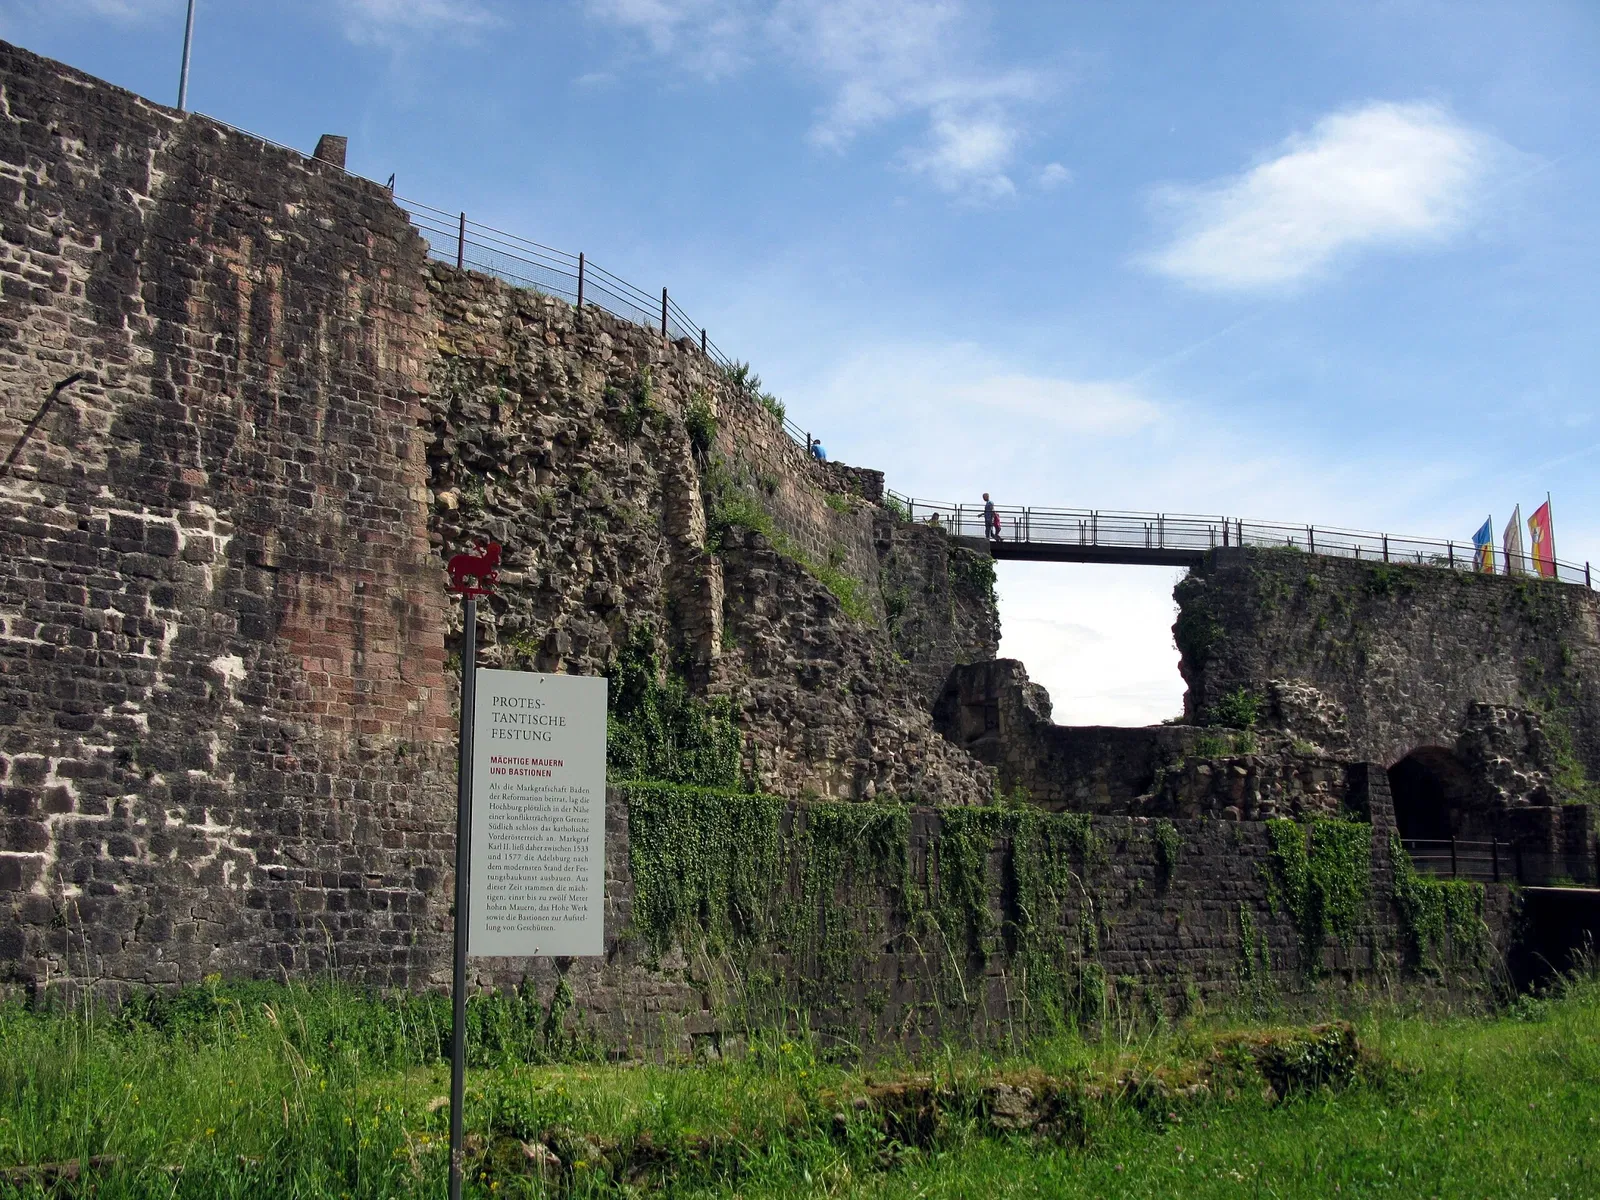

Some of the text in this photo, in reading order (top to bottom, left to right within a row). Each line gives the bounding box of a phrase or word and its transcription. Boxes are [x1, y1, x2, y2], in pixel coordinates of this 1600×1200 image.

[492, 696, 545, 709] PROTES-
[492, 712, 566, 726] TANTISCHE
[492, 728, 552, 741] FESTUNG
[491, 755, 563, 767] MÄCHTIGE MAUERN
[490, 767, 552, 777] UND BASTIONEN
[503, 783, 513, 791] die
[517, 784, 567, 794] Markgrafschaft
[570, 786, 589, 794] Baden
[502, 793, 542, 802] Reformation
[569, 796, 578, 805] lag
[580, 796, 589, 804] die
[489, 802, 522, 812] Hochburg
[524, 804, 551, 813] plötzlich
[489, 822, 513, 831] Südlich
[554, 825, 589, 833] katholische
[488, 833, 543, 842] Vorderösterreich
[559, 835, 589, 844] Markgraf
[488, 842, 502, 850] Karl
[512, 843, 524, 851] ließ
[544, 844, 571, 852] zwischen
[505, 853, 521, 861] 1577
[524, 853, 534, 861] die
[537, 854, 570, 863] Adelsburg
[488, 863, 501, 871] dem
[544, 864, 562, 872] Stand
[487, 873, 537, 881] tungsbaukunst
[487, 883, 506, 891] dieser
[509, 883, 522, 891] Zeit
[556, 884, 566, 892] die
[527, 893, 536, 901] bis
[487, 903, 506, 911] hohen
[509, 903, 536, 912] Mauern,
[551, 904, 569, 912] Hohe
[571, 904, 588, 912] Werk
[518, 914, 549, 922] Bastionen
[564, 914, 587, 922] Aufstel-
[486, 923, 501, 933] lung
